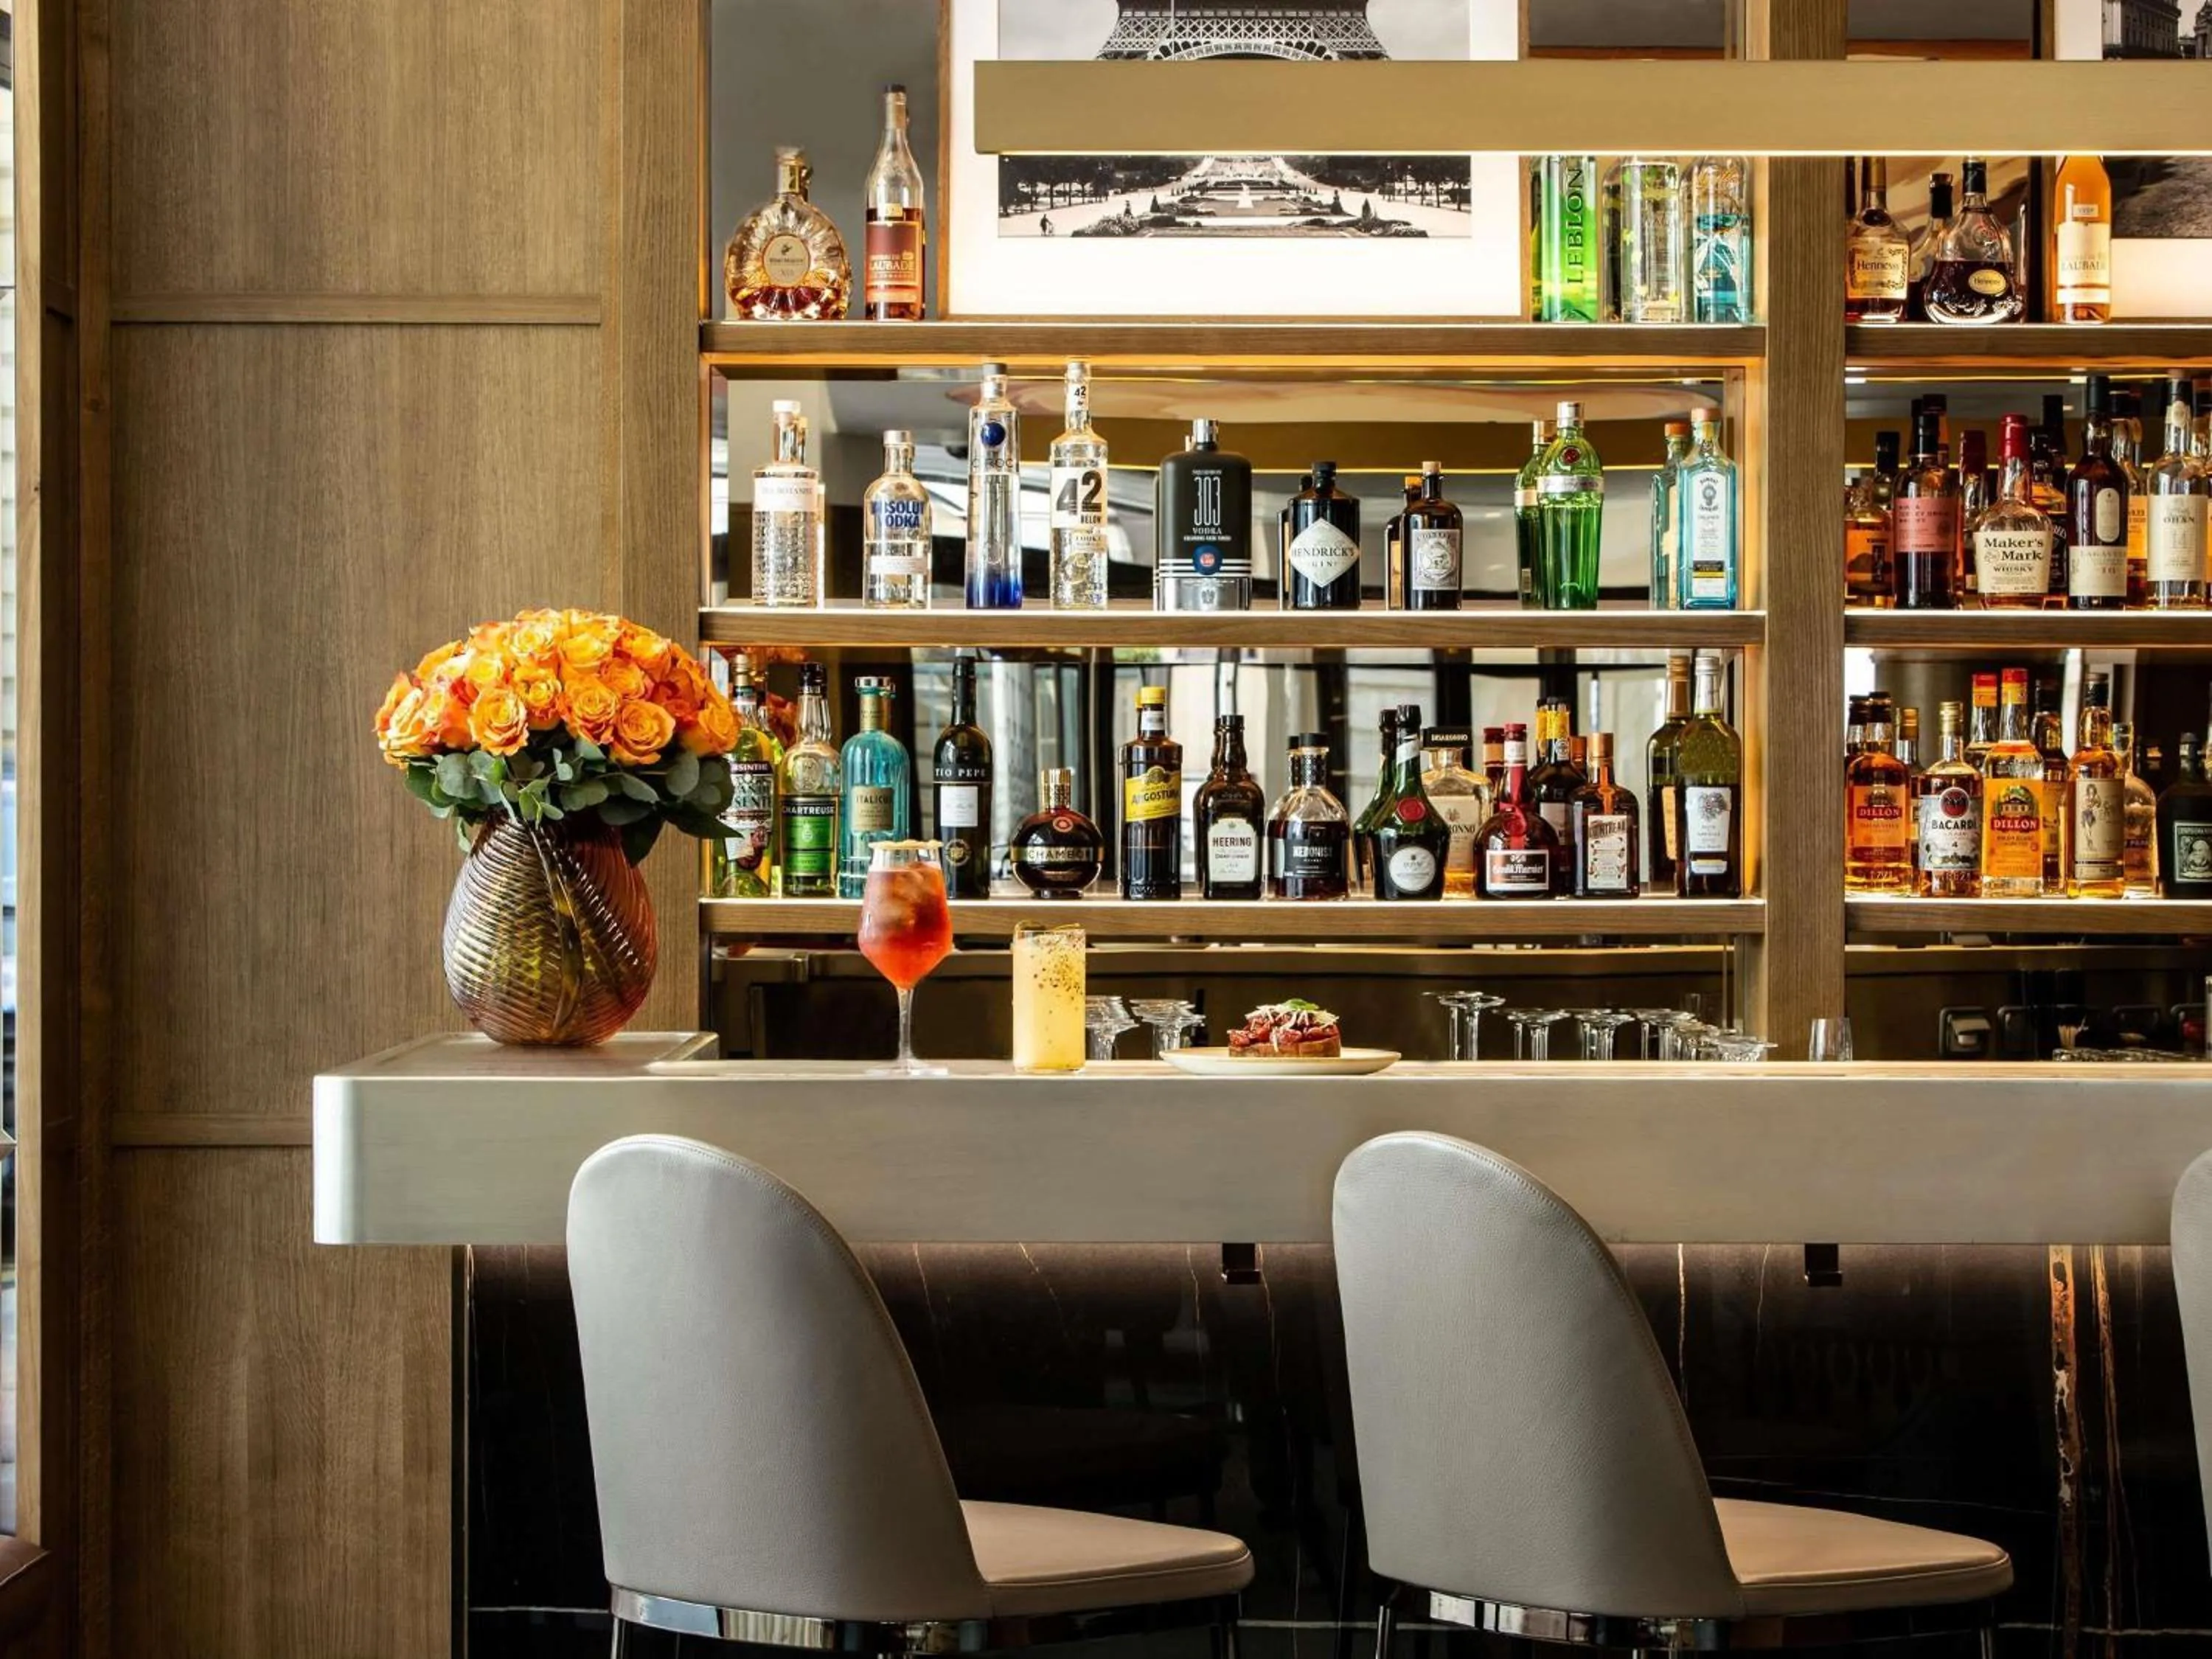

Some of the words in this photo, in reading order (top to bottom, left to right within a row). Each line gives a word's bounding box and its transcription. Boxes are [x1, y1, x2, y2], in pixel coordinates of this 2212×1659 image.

[1567, 167, 1584, 285] LEBLON
[1074, 386, 1087, 397] 42
[1056, 470, 1103, 515] 42
[1193, 476, 1221, 526] 303
[880, 514, 921, 529] ODKA
[1983, 537, 2045, 548] Maker's
[2000, 550, 2043, 561] Mark
[1859, 806, 1900, 816] DILLON
[1993, 818, 2037, 829] DILLON
[1212, 837, 1252, 847] HEERING
